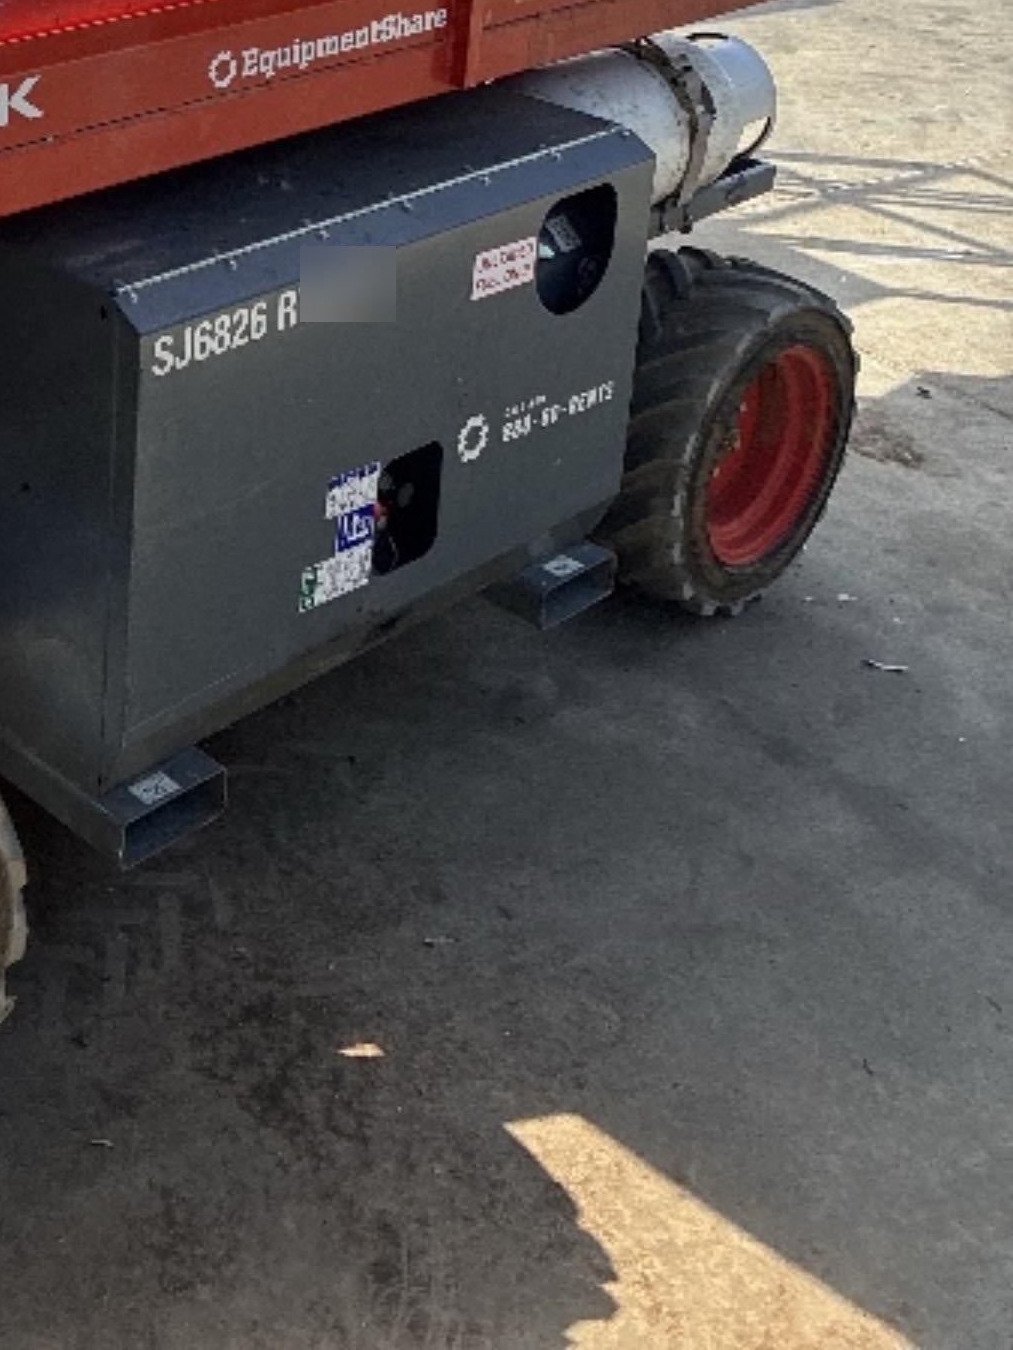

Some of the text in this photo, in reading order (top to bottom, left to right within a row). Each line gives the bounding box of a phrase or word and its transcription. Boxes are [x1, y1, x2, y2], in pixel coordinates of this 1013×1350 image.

[240, 7, 448, 79] EquipmentShare
[151, 287, 301, 377] SJ6826 R
